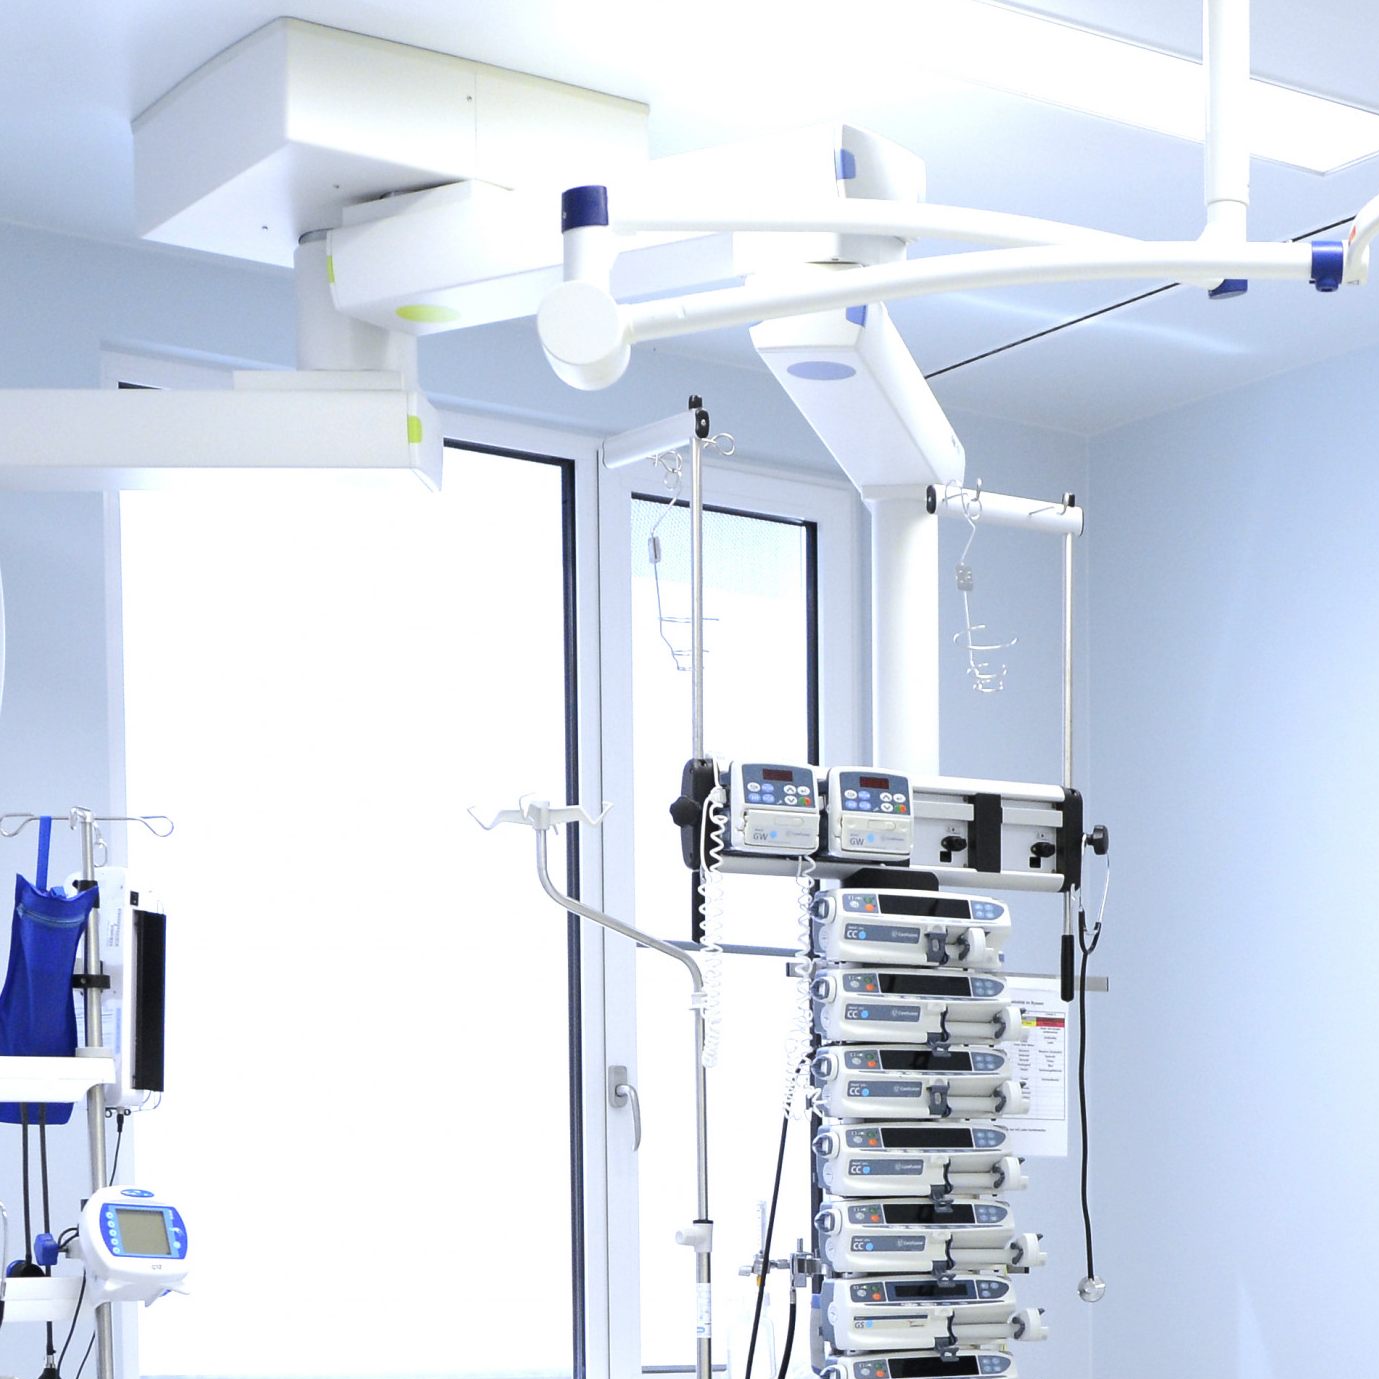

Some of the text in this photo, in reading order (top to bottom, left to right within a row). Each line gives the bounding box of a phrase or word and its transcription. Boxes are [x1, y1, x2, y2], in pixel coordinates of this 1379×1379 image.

[753, 833, 768, 841] GW
[849, 837, 865, 846] GW
[846, 930, 858, 939] CC
[847, 1010, 859, 1019] CC
[849, 1087, 860, 1095] CC
[851, 1166, 862, 1174] CC
[853, 1242, 864, 1250] CC
[854, 1321, 865, 1329] GS
